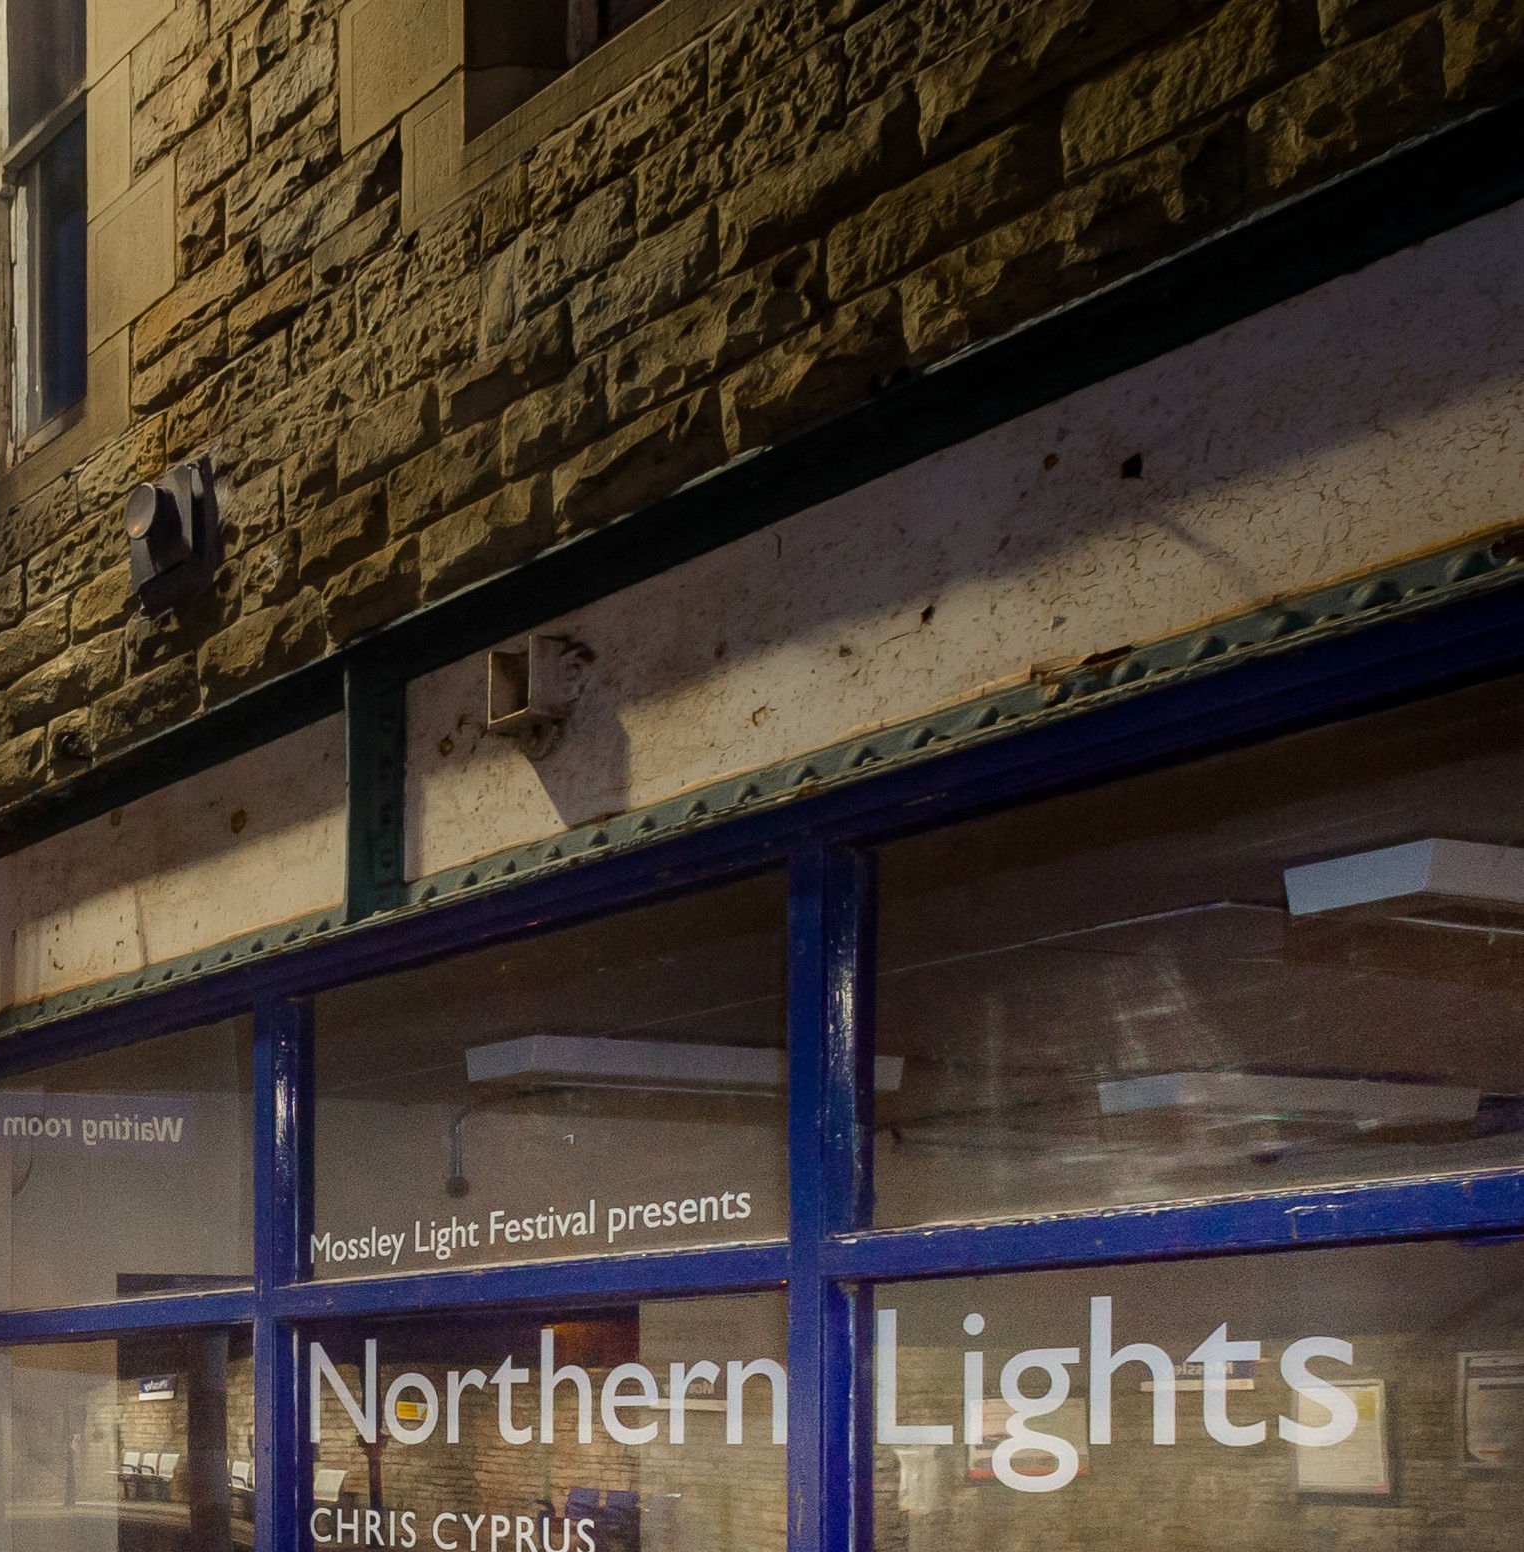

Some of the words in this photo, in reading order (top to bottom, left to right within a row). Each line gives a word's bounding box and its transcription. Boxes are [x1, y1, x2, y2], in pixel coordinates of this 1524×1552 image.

[310, 1227, 405, 1264] Mossley
[414, 1215, 480, 1260] Light
[489, 1199, 595, 1245] Festival
[607, 1191, 752, 1242] presents
[309, 1328, 789, 1445] Northern
[876, 1296, 1359, 1493] Lights
[310, 1507, 417, 1548] CHRIS
